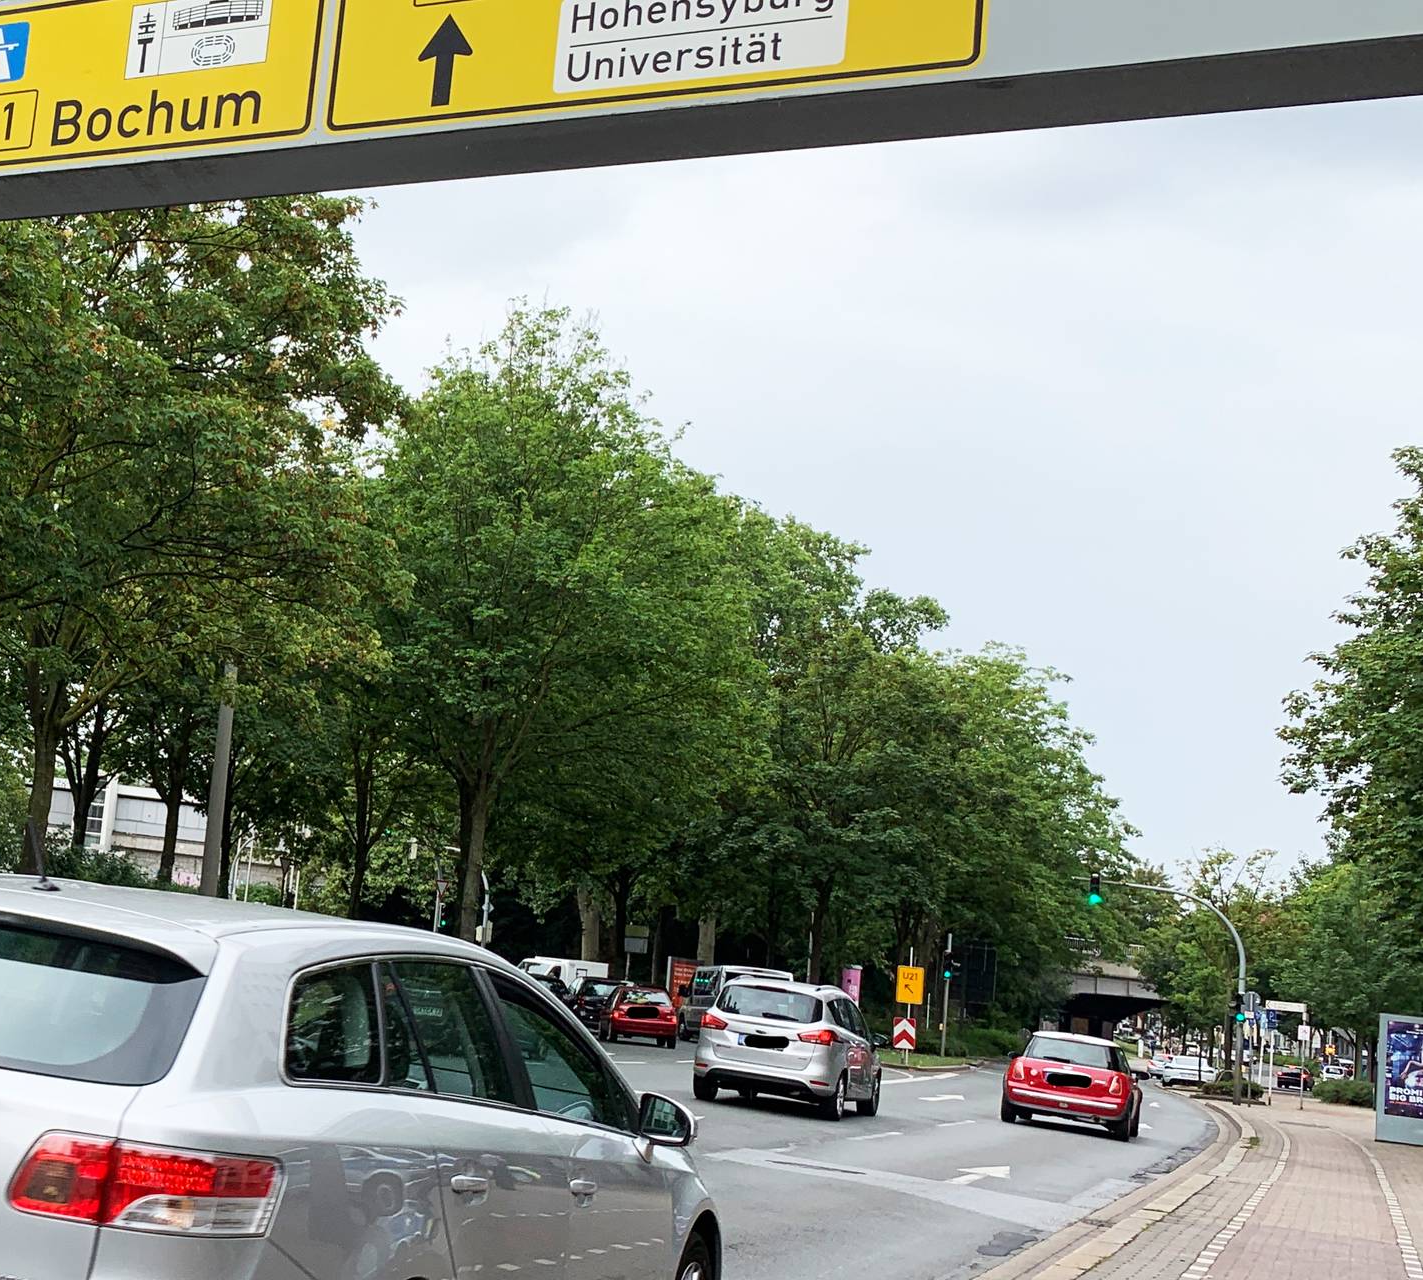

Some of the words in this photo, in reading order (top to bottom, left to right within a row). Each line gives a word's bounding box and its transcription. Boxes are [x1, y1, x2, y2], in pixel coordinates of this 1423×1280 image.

[571, 0, 835, 33] Hohensyb
[567, 32, 782, 83] Universität
[50, 89, 263, 147] Bochum
[902, 972, 918, 980] U21
